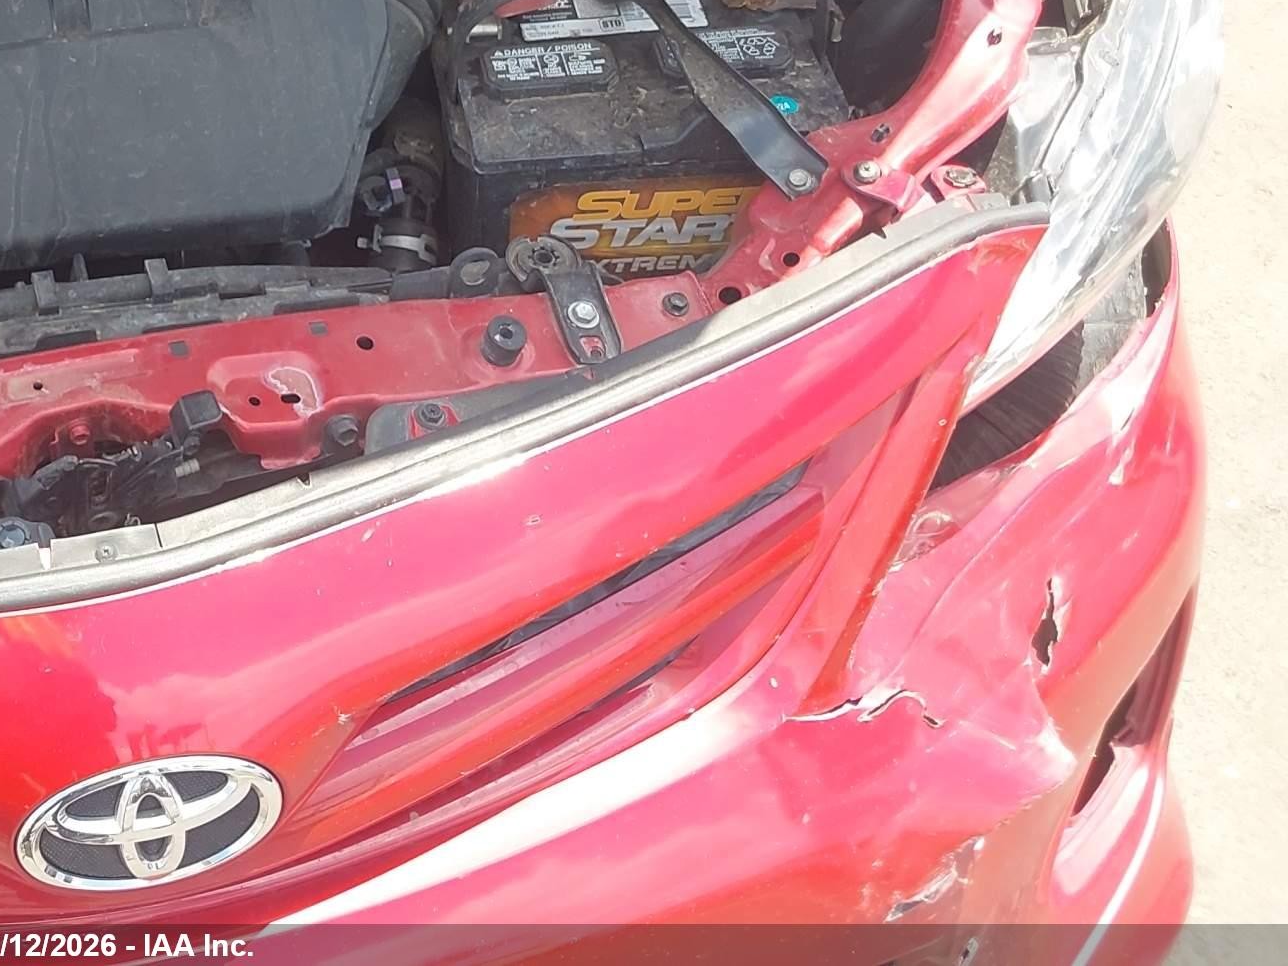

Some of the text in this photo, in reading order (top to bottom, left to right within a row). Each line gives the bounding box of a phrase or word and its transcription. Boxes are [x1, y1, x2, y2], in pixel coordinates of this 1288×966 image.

[504, 46, 544, 57] DANGER
[555, 42, 592, 53] POISON
[550, 214, 736, 250] STAR
[588, 254, 713, 274] XTREM
